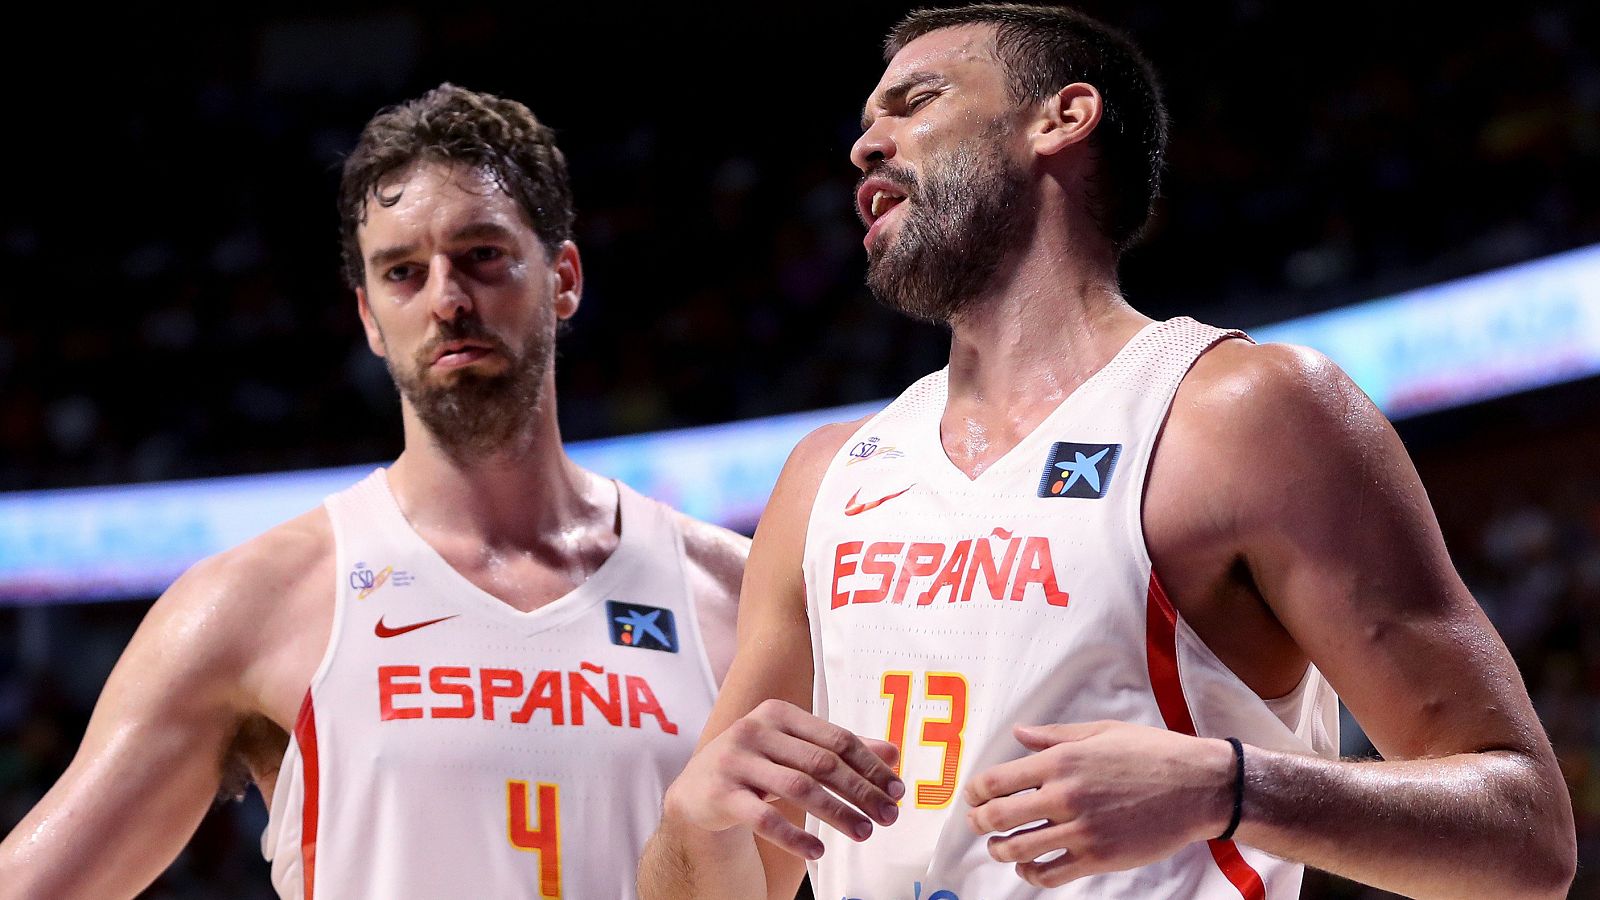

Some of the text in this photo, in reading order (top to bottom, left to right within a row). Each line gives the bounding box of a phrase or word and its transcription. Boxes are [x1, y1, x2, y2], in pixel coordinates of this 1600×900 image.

[849, 441, 878, 458] CSD
[350, 569, 374, 590] CSD
[831, 527, 1070, 610] ESPAÑA
[378, 661, 679, 735] ESPAÑA
[880, 670, 969, 810] 13
[507, 778, 562, 900] 4
